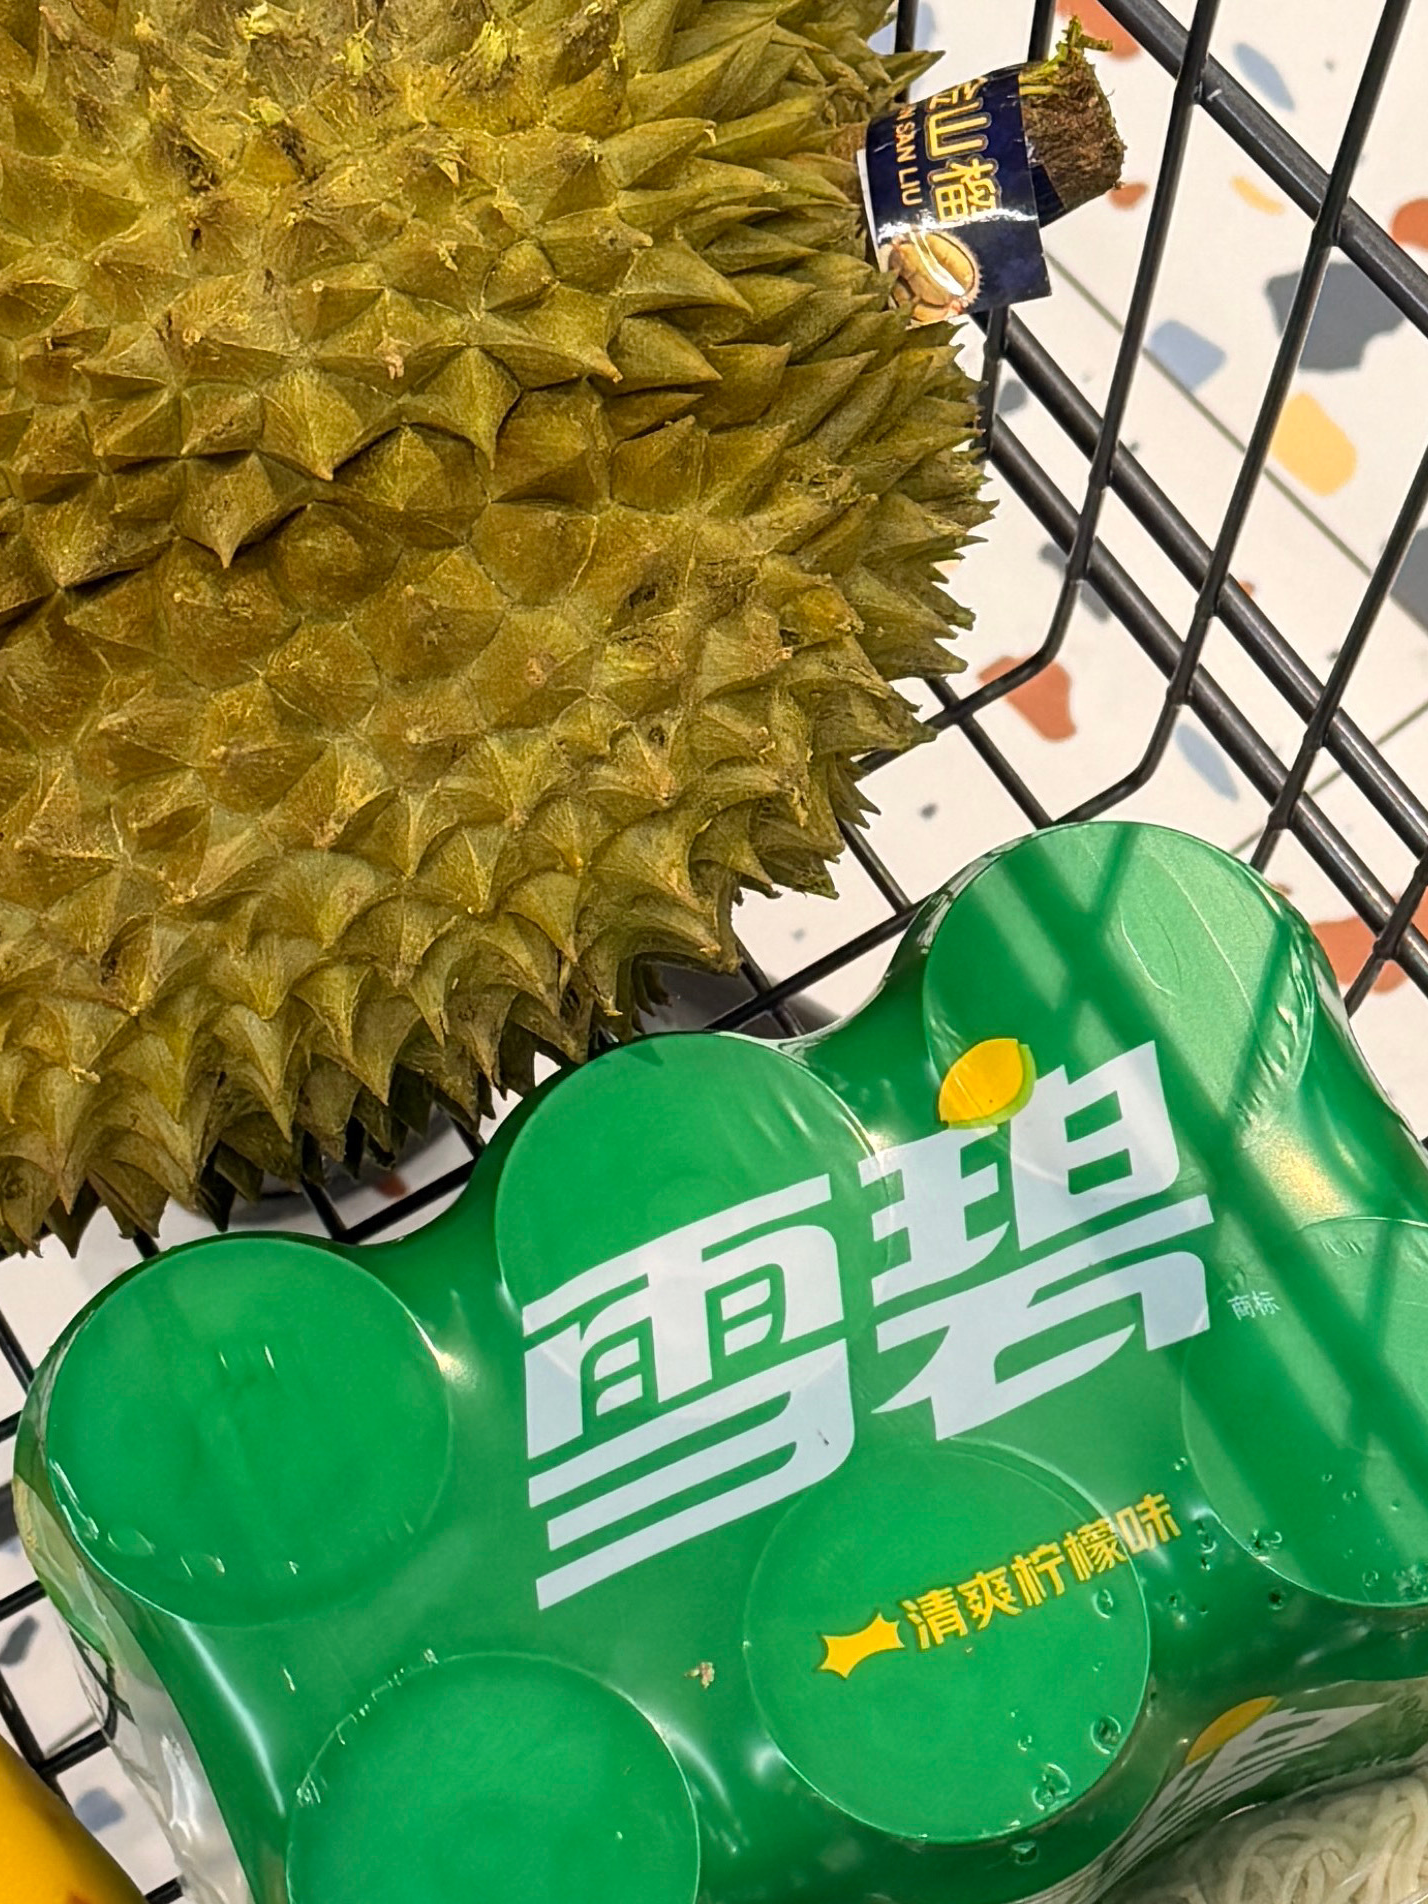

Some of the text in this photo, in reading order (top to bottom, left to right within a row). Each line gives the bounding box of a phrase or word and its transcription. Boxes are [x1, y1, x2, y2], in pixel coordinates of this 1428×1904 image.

[895, 121, 917, 162] SAN
[898, 167, 922, 206] LIU
[522, 1039, 1215, 1611] 雪碧
[905, 1492, 1183, 1650] 清爽柠檬味
